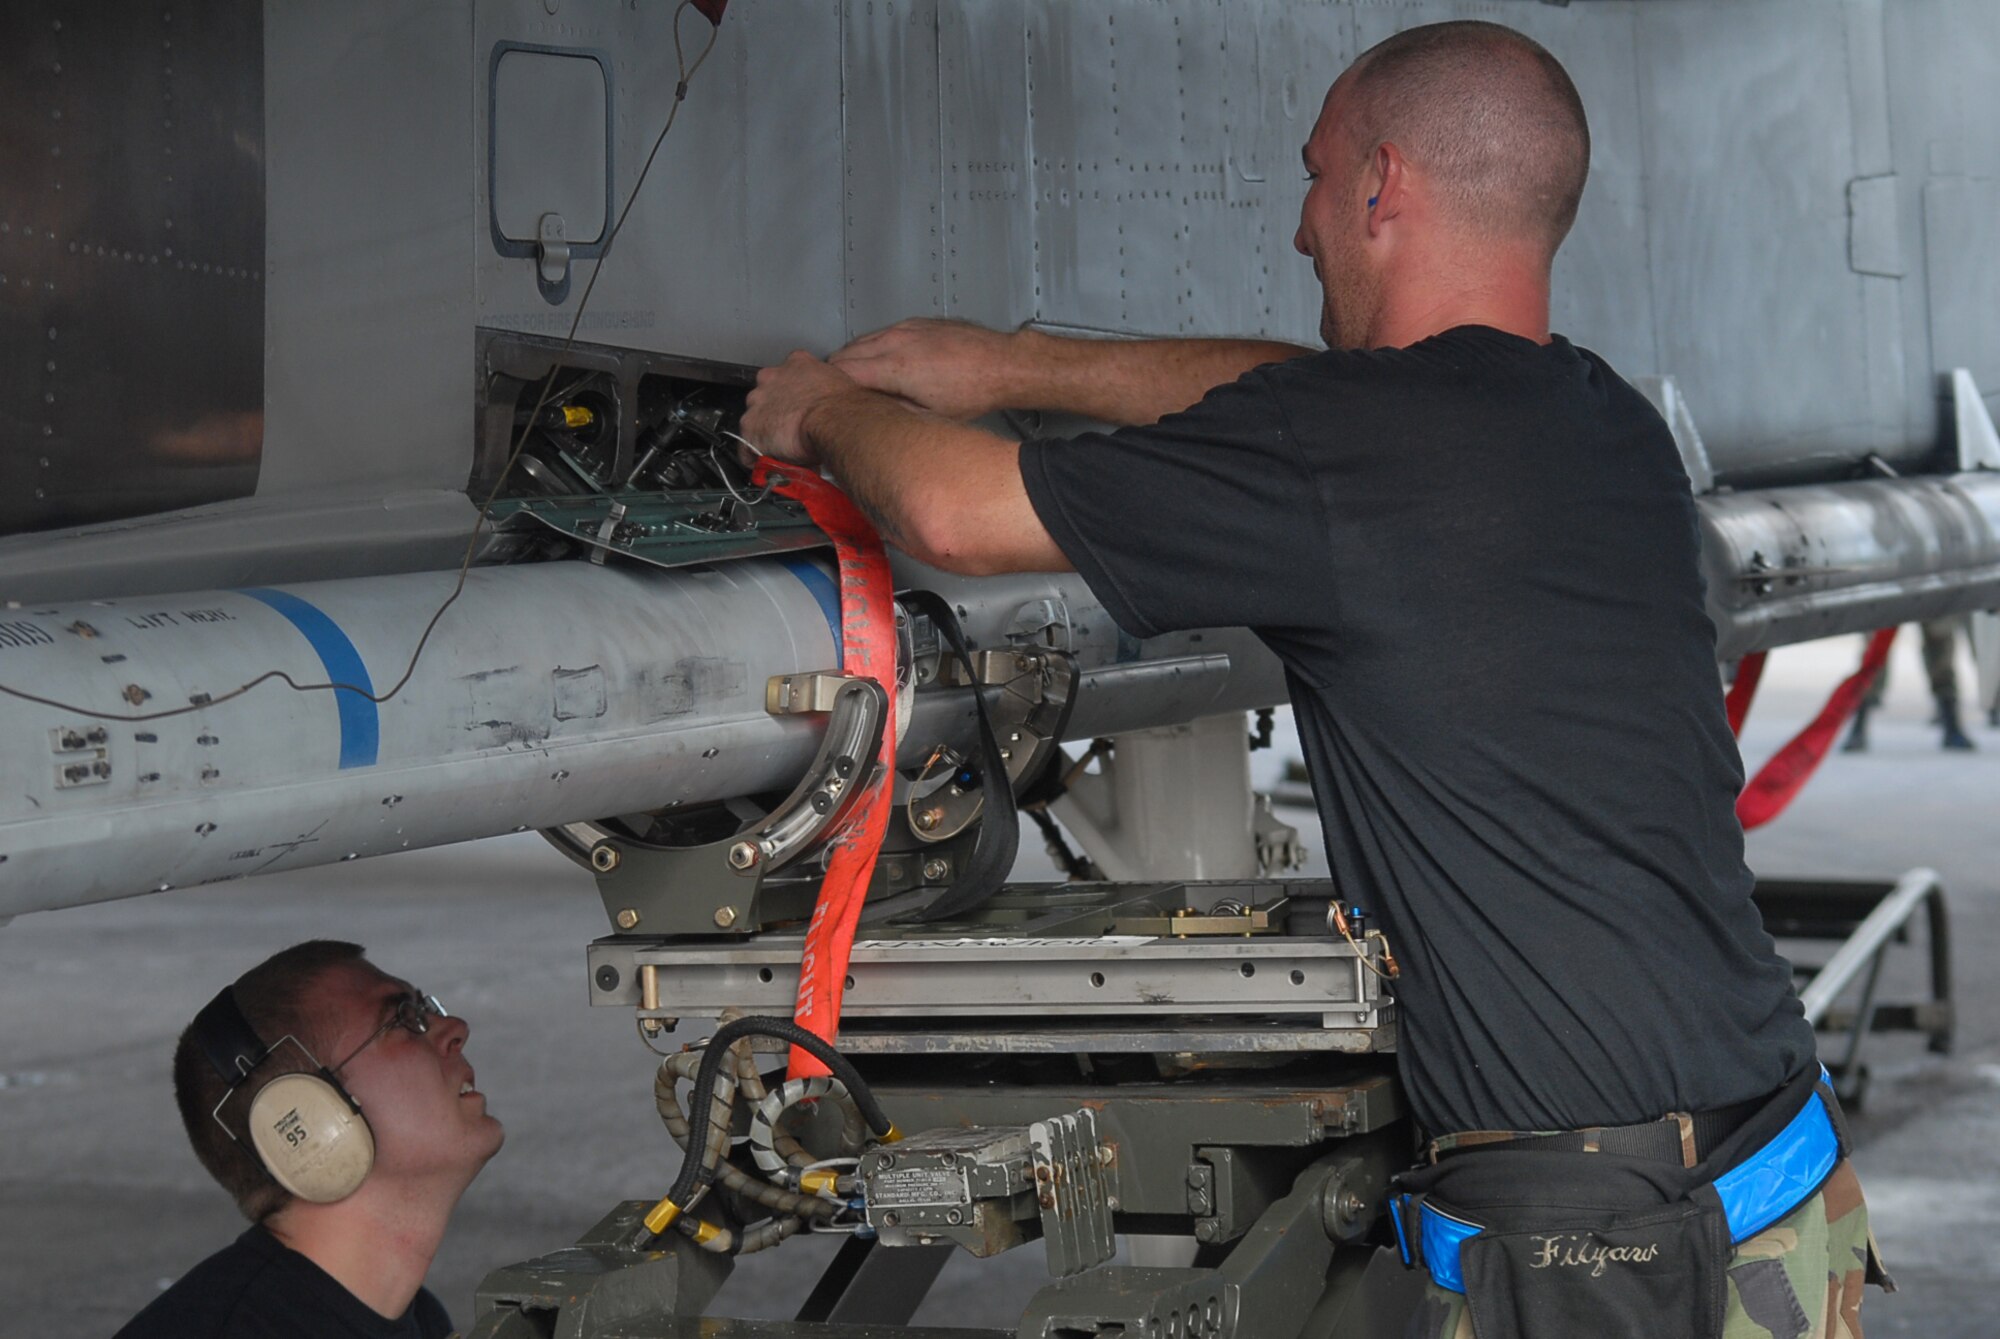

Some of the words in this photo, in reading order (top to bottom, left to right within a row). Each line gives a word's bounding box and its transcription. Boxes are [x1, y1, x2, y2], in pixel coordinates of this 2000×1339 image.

[548, 312, 572, 330] FIRE
[286, 1125, 307, 1147] 95
[878, 1172, 910, 1180] MULTIPLE
[875, 1191, 910, 1199] STANDARD
